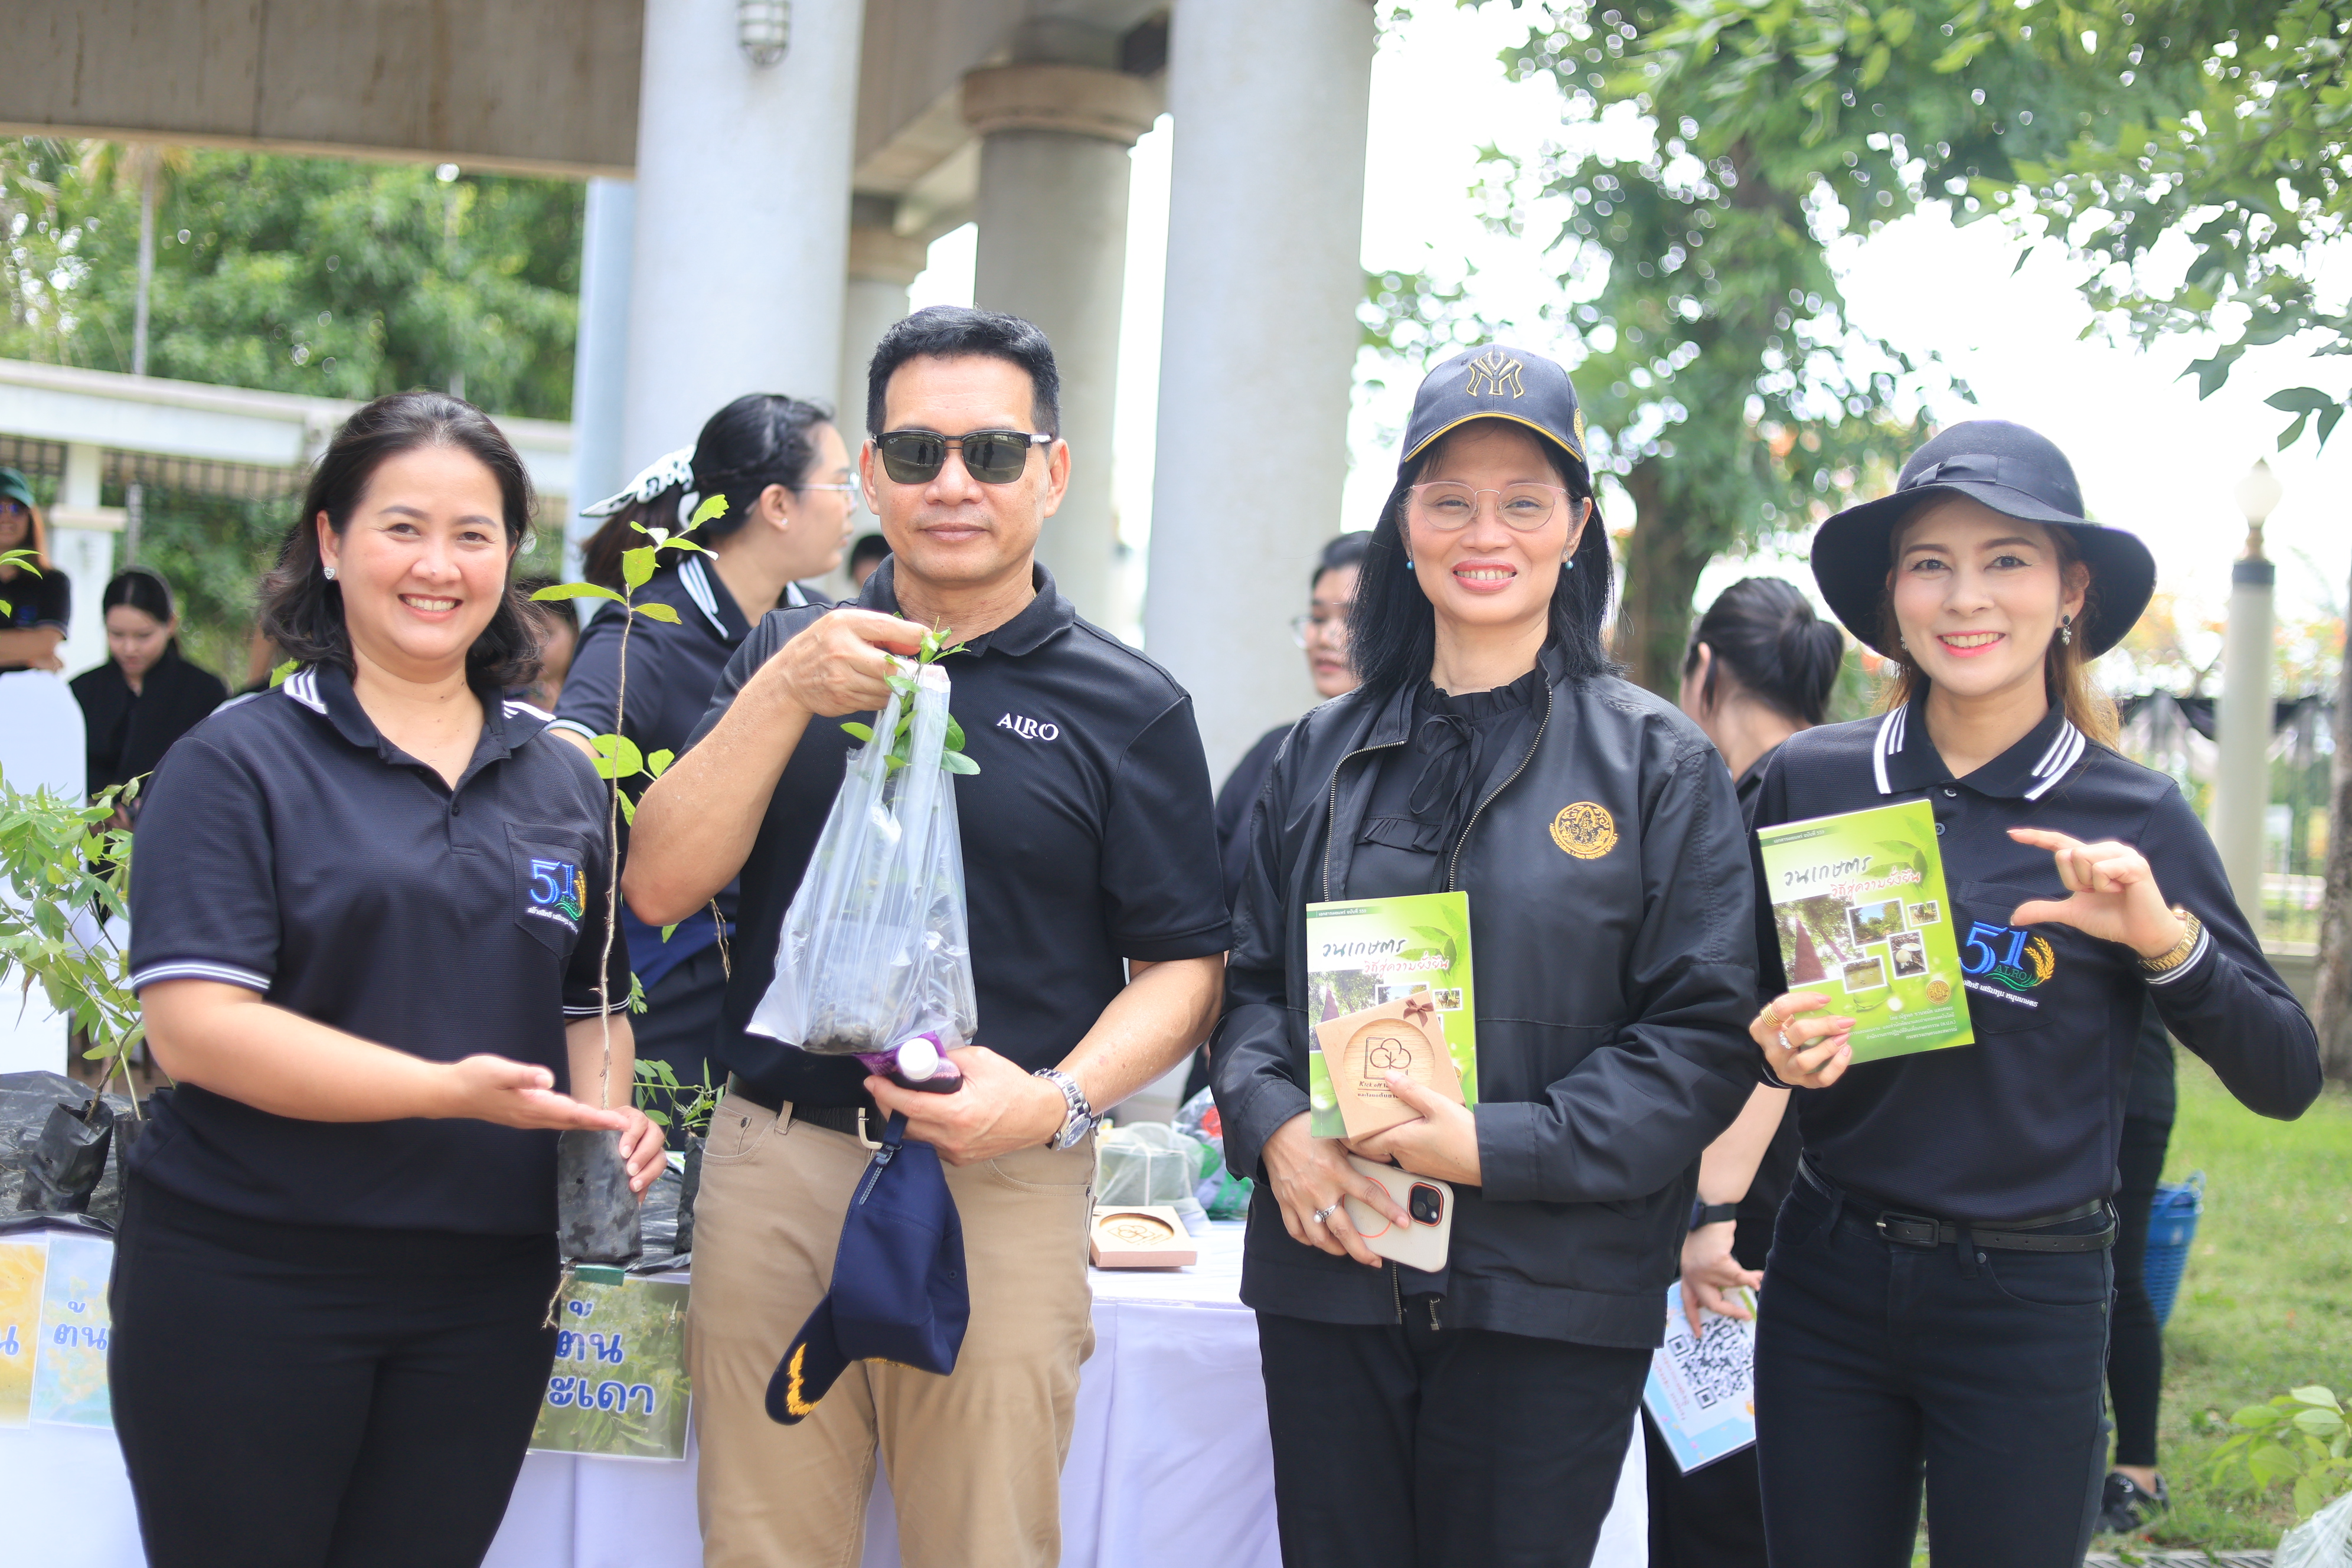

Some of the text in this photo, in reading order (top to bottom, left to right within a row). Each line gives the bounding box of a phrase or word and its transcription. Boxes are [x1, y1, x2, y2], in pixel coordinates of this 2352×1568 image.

[1572, 851, 1585, 860] LAND
[1586, 849, 1607, 860] REFORM
[1605, 835, 1618, 852] OFFICE
[530, 858, 577, 904] 51
[1783, 855, 1873, 887] วนเกษตร
[1831, 865, 1921, 901] วิถีสู่ความยั่งยืน
[1322, 938, 1407, 958] วนเกษตร
[1958, 920, 2028, 975] 51
[1363, 951, 1450, 979] วิถีสู่ความยั่งยืน
[1993, 965, 2027, 981] ALRO
[53, 1300, 108, 1351] ต้น
[556, 1300, 624, 1364] ต้น
